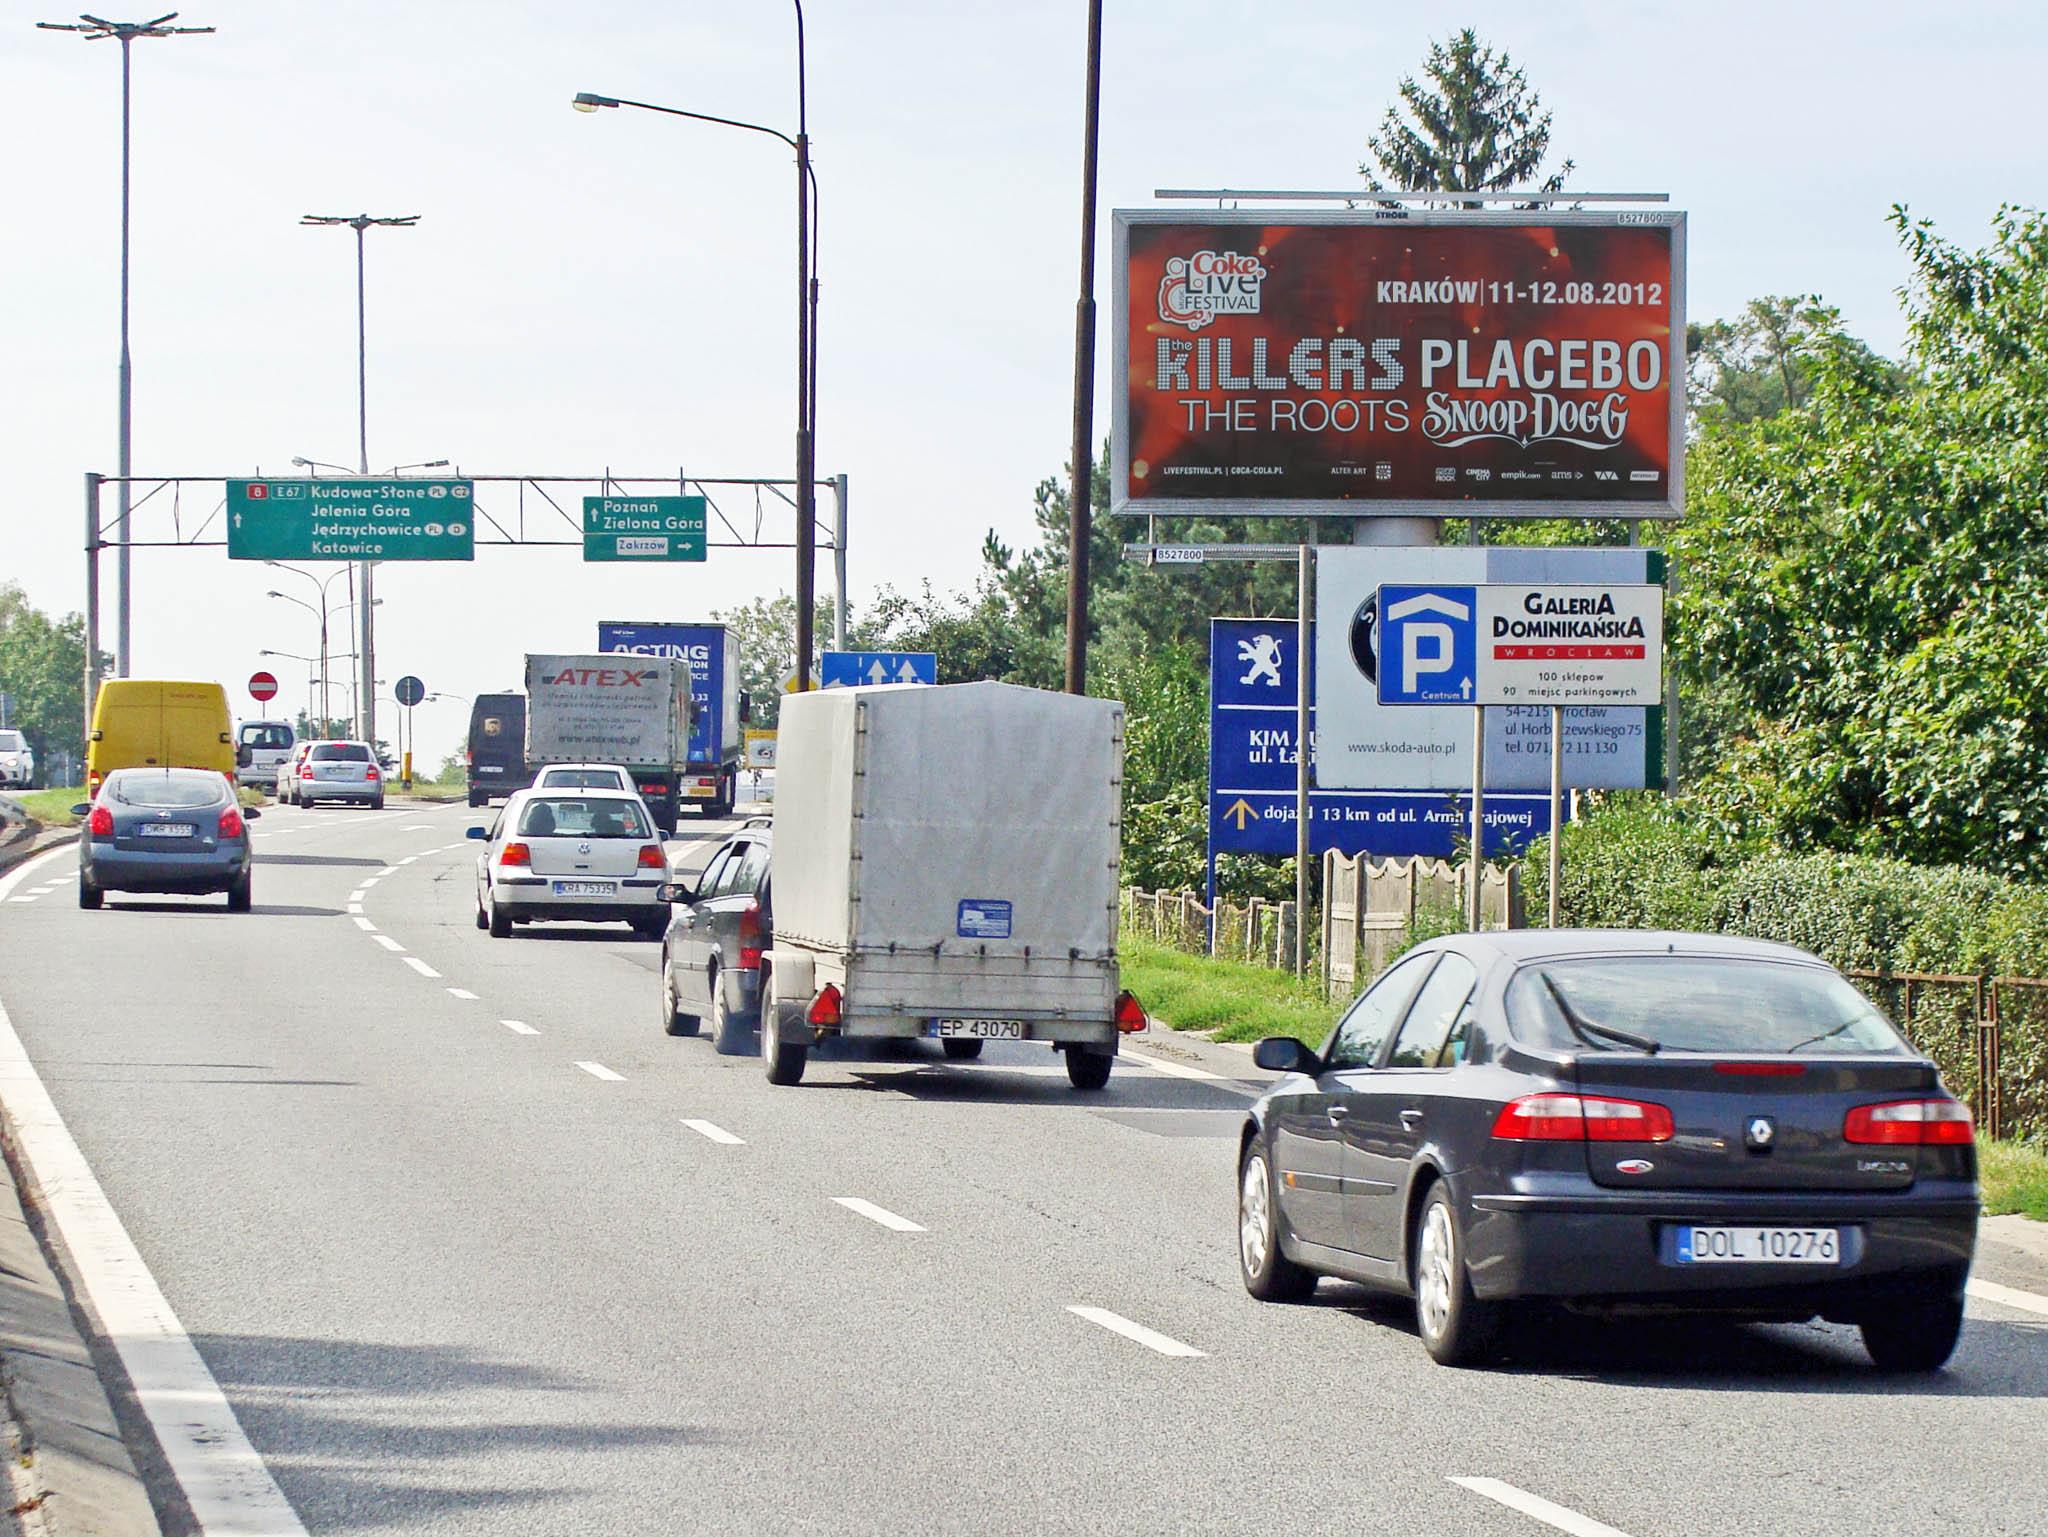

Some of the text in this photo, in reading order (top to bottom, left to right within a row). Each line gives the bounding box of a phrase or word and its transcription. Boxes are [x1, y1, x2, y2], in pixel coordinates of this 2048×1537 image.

[1618, 213, 1663, 224] 8527800
[1193, 253, 1257, 275] Coke
[1377, 275, 1662, 305] KRAKÓW 11-12.08.2012
[1185, 296, 1258, 310] FESTIVAL
[1421, 338, 1661, 391] PLACEBO
[1178, 399, 1410, 432] THE ROOTS
[1163, 467, 1223, 475] LIVEFESTIVAL.PL
[1231, 467, 1283, 475] COCA-COLA.PL
[1501, 470, 1541, 480] empik.com
[277, 487, 300, 497] E 67
[311, 485, 425, 499] Kudowa-Słone
[431, 488, 443, 496] PL
[311, 503, 411, 517] Jelenia Góra
[604, 500, 658, 513] Poznań
[603, 516, 703, 530] Zielona Góra
[312, 523, 422, 538] Jędrzychowice
[428, 526, 439, 534] PL
[312, 541, 383, 554] Katowice
[619, 540, 665, 550] Zakrzów
[1157, 550, 1201, 560] 8527800
[1524, 592, 1616, 615] GALERIA
[1403, 622, 1454, 693] P
[1504, 648, 1635, 657] WROCŁAW
[554, 668, 645, 687] ATEX
[1538, 672, 1558, 681] 100
[1421, 691, 1460, 700] Centrum
[1503, 686, 1516, 696] 90
[1565, 687, 1637, 698] parkingowych
[1627, 724, 1642, 736] 75
[1249, 730, 1290, 747] KIM
[1249, 746, 1273, 763] ul.
[1348, 742, 1456, 757] www.skoda-auto.pl
[1595, 743, 1618, 754] 130
[1322, 808, 1341, 821] 13
[1345, 807, 1370, 821] km
[1376, 808, 1396, 823] od
[1399, 808, 1417, 823] ul.
[940, 1020, 1020, 1037] EP 43070
[1694, 1230, 1835, 1259] DOL 10276
